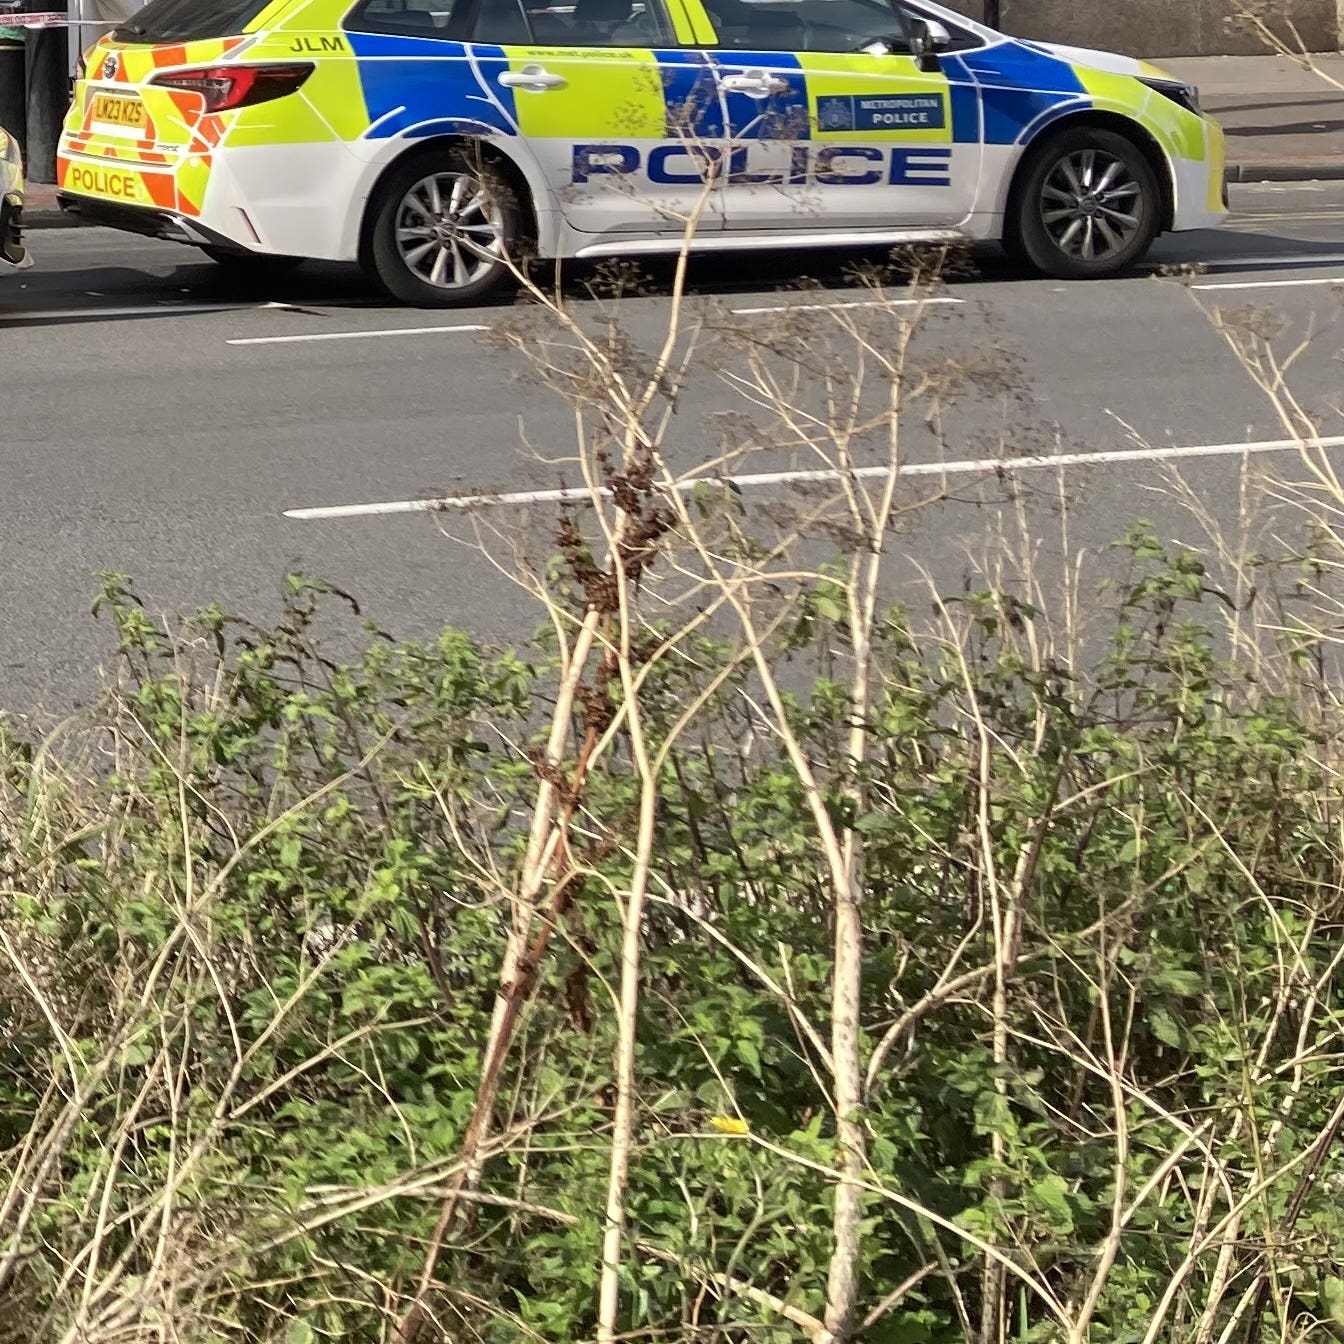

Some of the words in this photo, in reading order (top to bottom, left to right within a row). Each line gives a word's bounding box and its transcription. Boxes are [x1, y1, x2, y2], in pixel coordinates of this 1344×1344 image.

[289, 36, 344, 52] JLM
[861, 99, 938, 110] METROPOLITAN
[873, 112, 929, 124] POLICE
[572, 144, 952, 186] POLICE
[72, 167, 136, 198] POLICE
